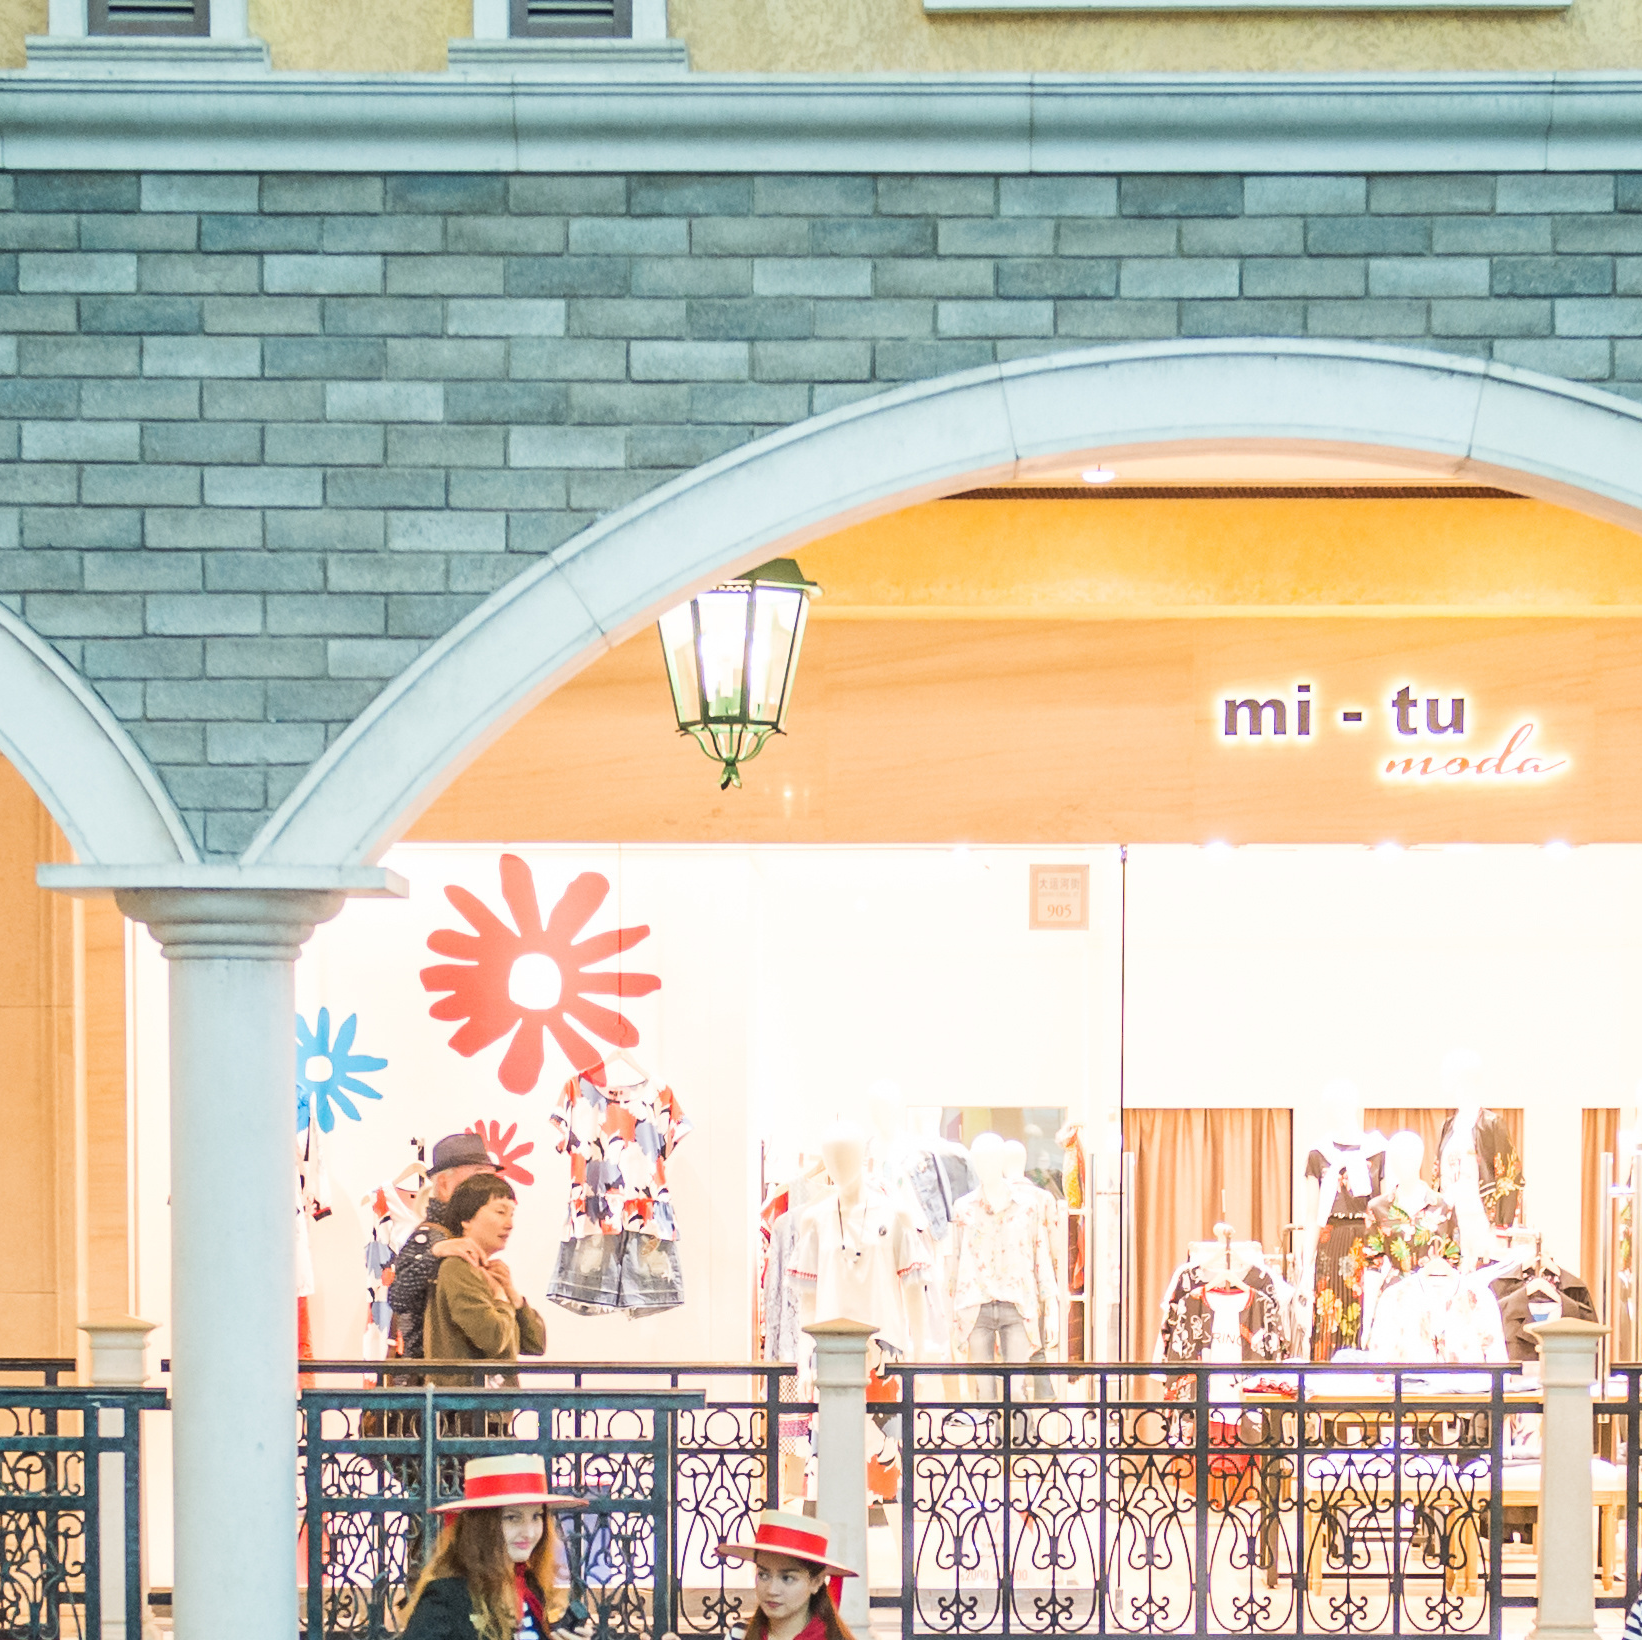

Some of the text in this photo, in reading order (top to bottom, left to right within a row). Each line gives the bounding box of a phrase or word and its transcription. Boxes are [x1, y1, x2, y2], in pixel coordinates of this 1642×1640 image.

[1224, 684, 1311, 735] mi
[1392, 685, 1464, 734] tu
[1385, 722, 1567, 776] moda
[1047, 904, 1072, 918] 905
